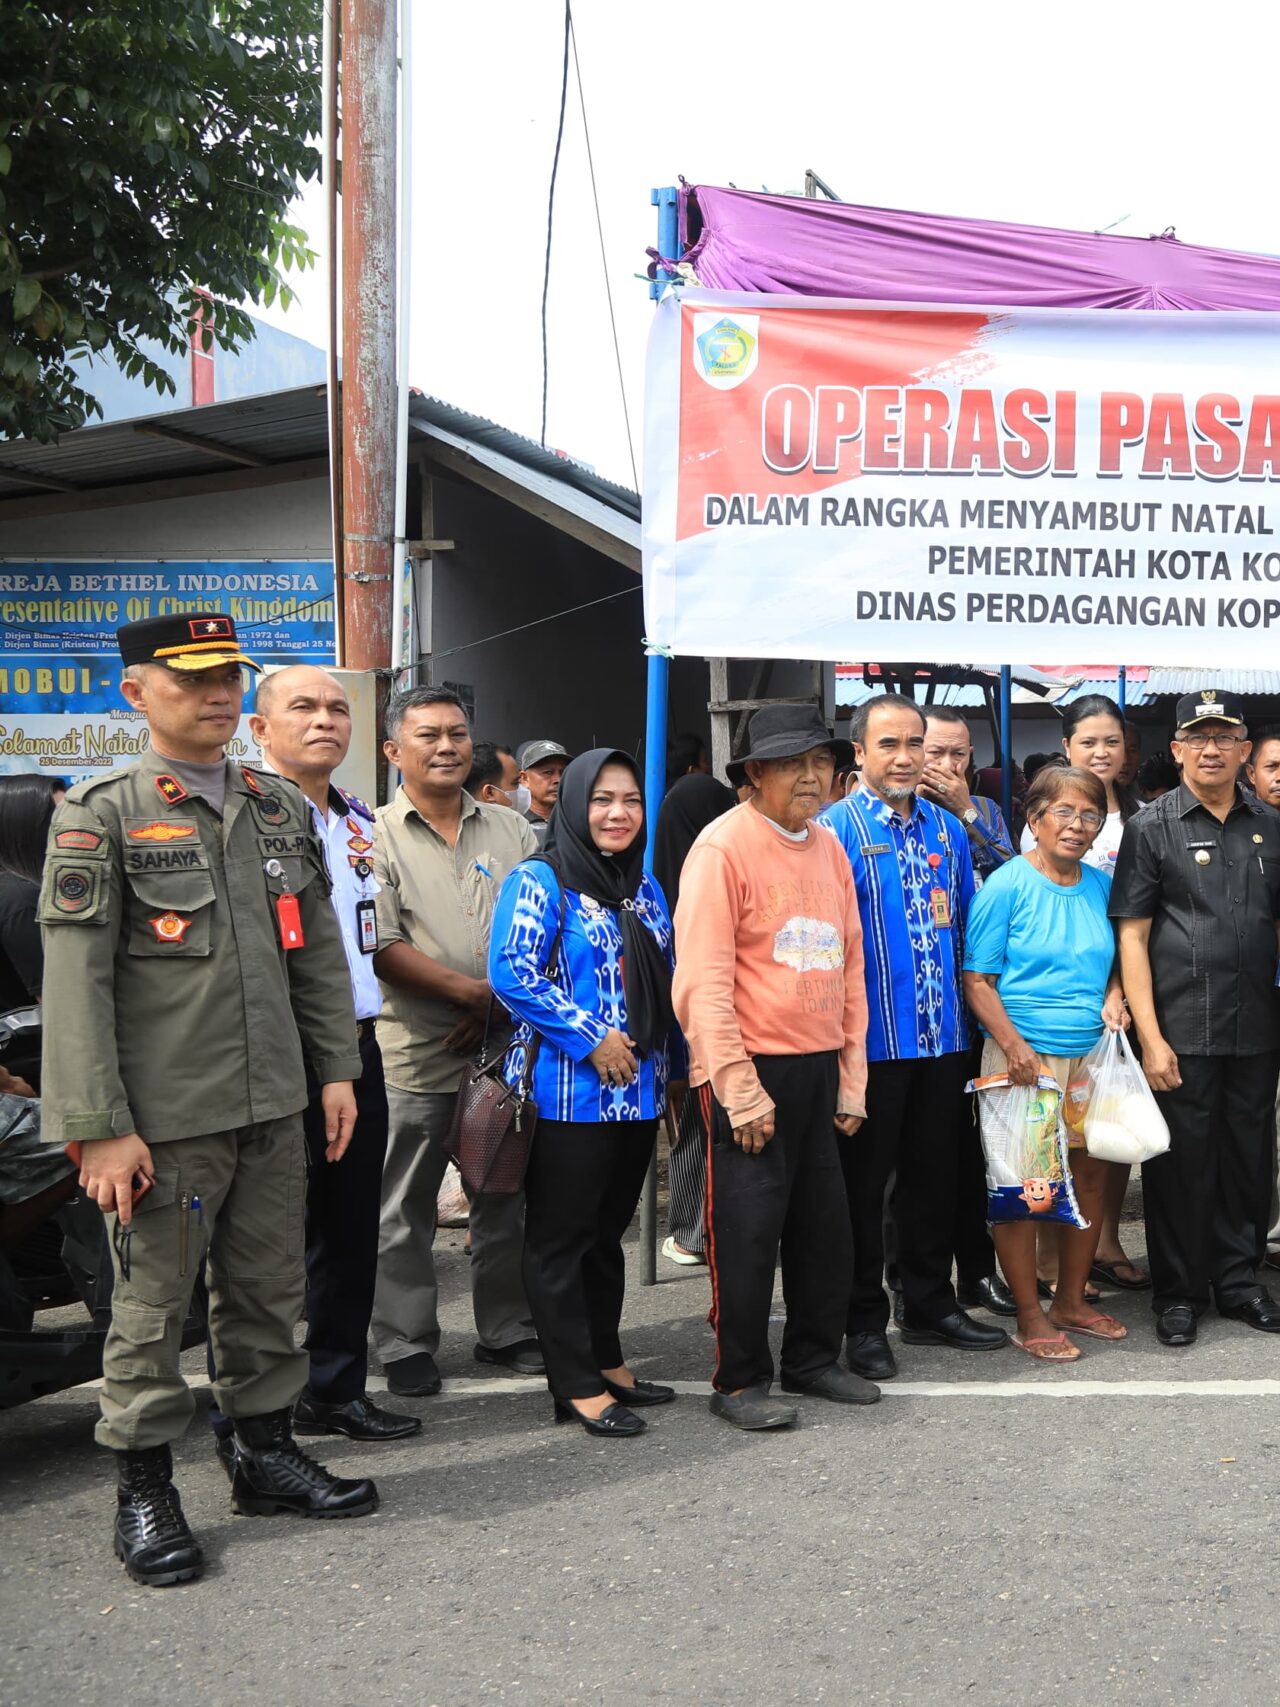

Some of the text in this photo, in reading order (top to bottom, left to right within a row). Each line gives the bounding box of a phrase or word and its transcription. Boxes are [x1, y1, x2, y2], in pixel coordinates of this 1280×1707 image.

[762, 384, 1078, 479] OPERASI
[707, 496, 809, 526] DALAM
[821, 497, 949, 529] RANGKA
[961, 500, 1161, 533] MENYAMBUT
[1172, 504, 1273, 536] NATAL
[928, 546, 1136, 579] PEMERINTAH
[1148, 549, 1230, 580] KOTA
[69, 575, 170, 591] BETHEL
[178, 574, 319, 591] INDONESIA
[0, 597, 119, 623] esentative
[230, 597, 334, 626] Kingdom
[856, 591, 955, 621] DINAS
[967, 592, 1204, 627] PERDAGANGAN
[4, 641, 31, 650] Dirjen
[61, 641, 99, 649] (Kristen)
[276, 641, 309, 650] Tanggal
[5, 632, 31, 641] Dirjen
[84, 724, 149, 756] Natal
[39, 757, 51, 766] 25
[51, 757, 92, 766] Desember
[93, 757, 113, 766] 2022
[131, 852, 201, 870] SAHAYA
